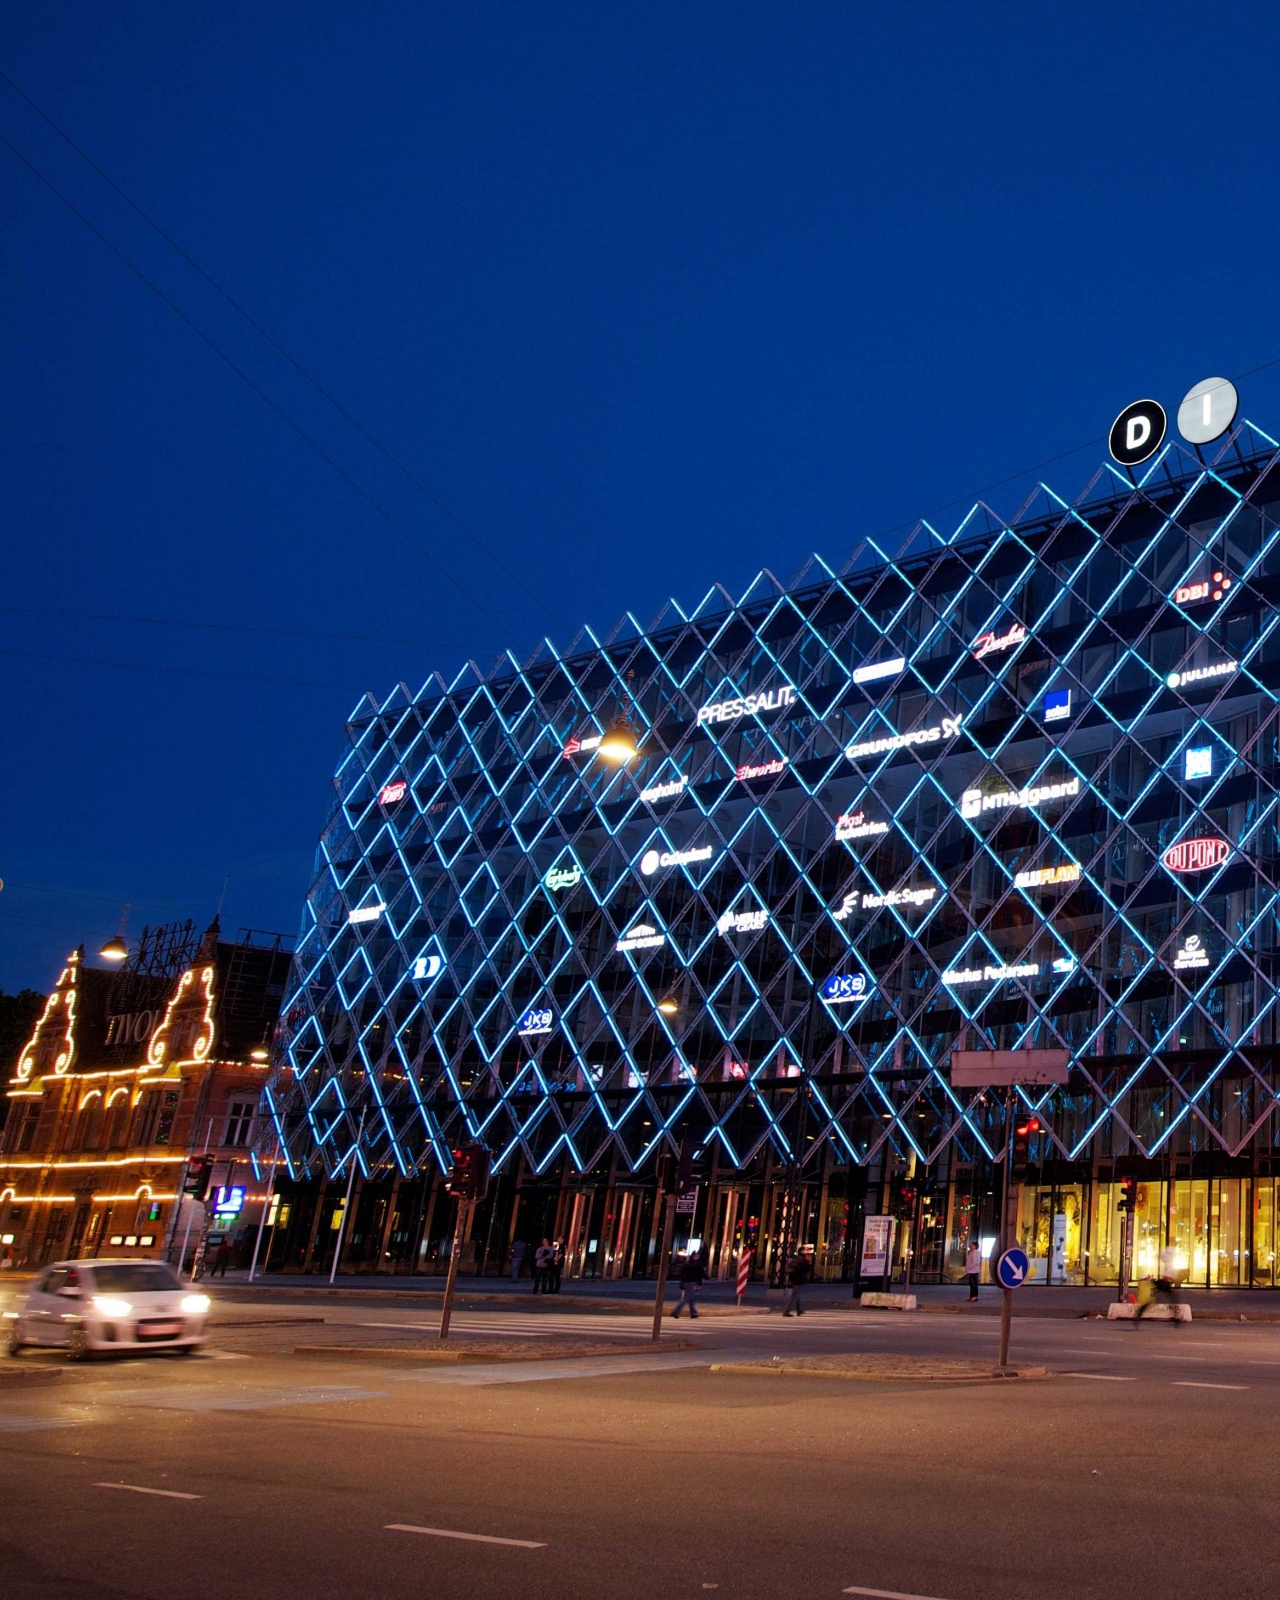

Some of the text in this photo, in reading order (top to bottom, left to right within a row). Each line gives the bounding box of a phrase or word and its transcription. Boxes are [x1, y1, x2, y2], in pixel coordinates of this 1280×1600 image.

[1176, 582, 1209, 604] DBI
[1181, 661, 1236, 686] JULIANA
[845, 727, 941, 758] GRUNDFOS
